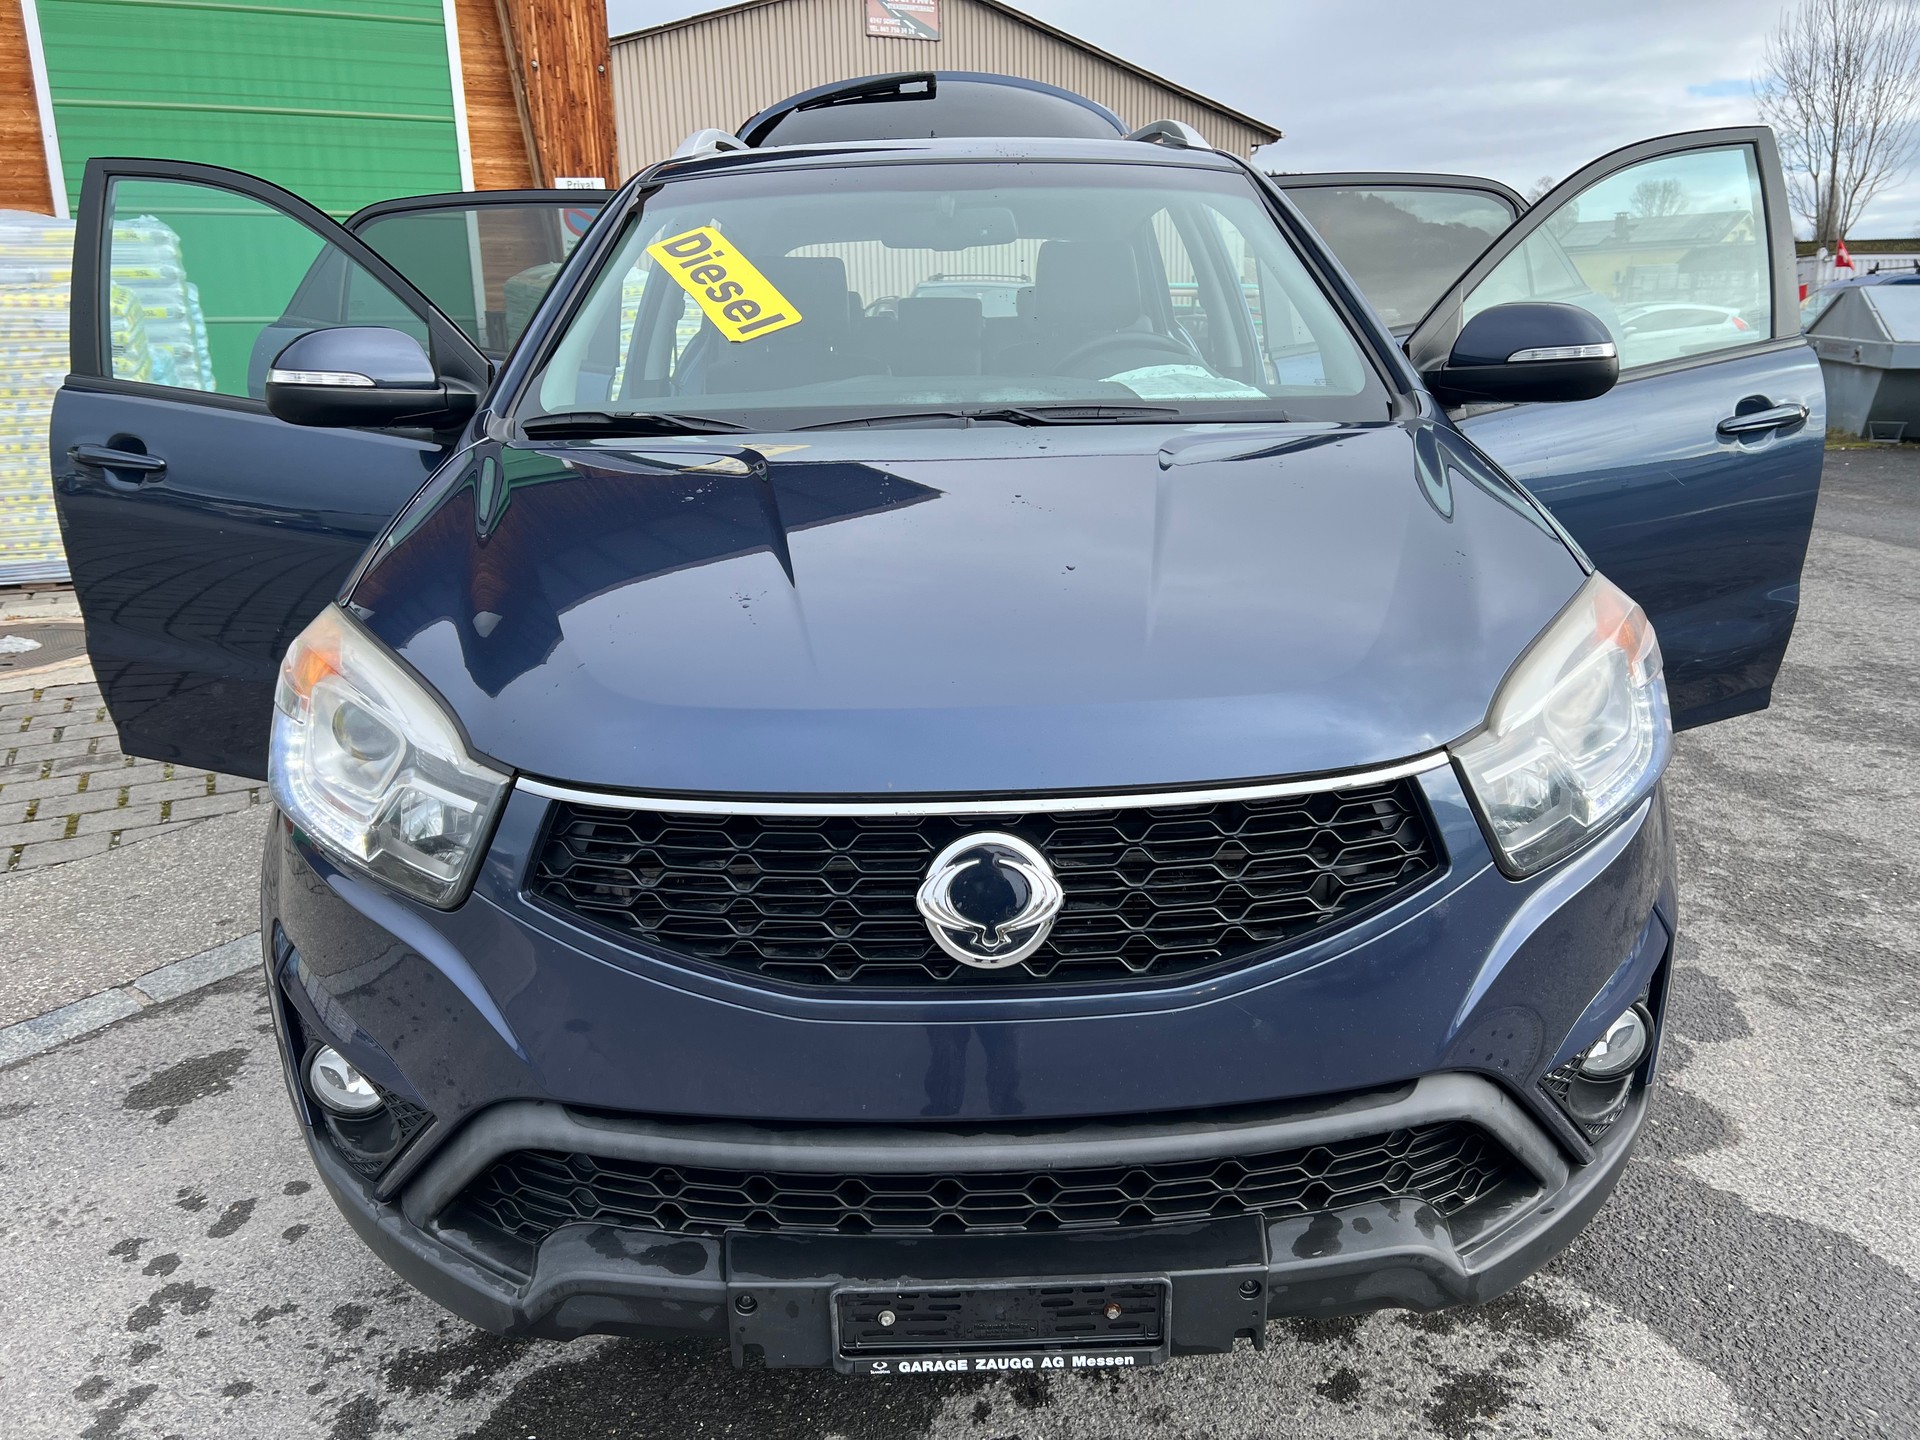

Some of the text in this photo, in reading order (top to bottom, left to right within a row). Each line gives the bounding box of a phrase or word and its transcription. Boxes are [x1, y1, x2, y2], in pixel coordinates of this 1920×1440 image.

[566, 181, 595, 189] Privat
[661, 232, 786, 334] Diesel
[898, 1355, 1135, 1373] GARAGE ZAUGG AG Messen
